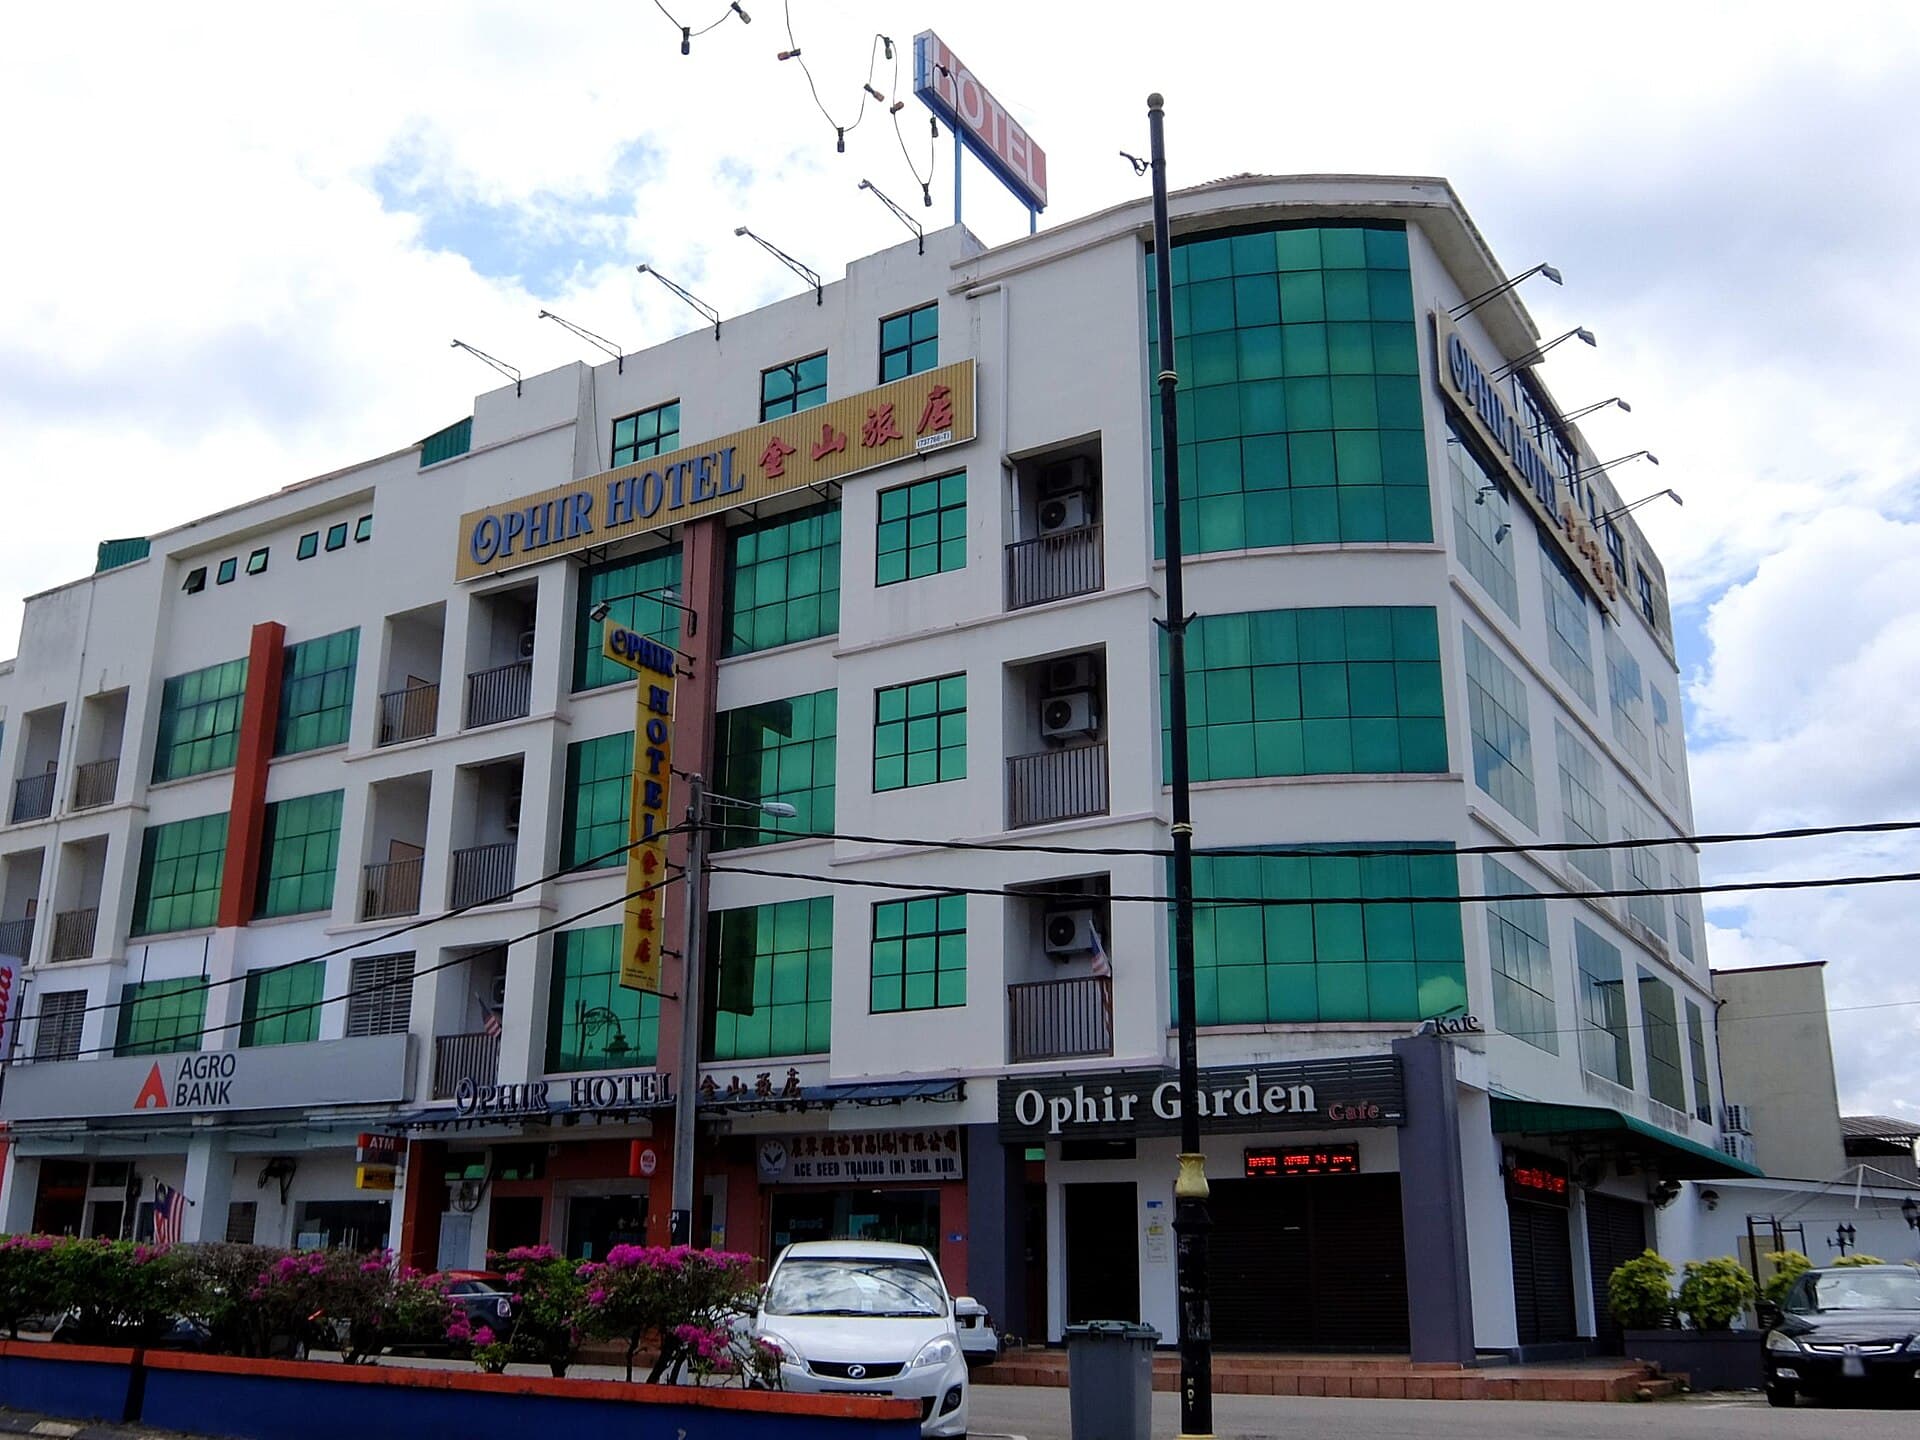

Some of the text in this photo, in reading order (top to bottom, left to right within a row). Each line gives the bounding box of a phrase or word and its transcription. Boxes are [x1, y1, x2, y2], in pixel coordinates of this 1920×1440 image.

[933, 38, 1046, 200] HOTEL
[759, 384, 954, 479] 金山旅店
[470, 446, 745, 565] OPHIR HOTEL
[610, 627, 675, 678] OPHIR
[642, 684, 670, 844] HOTEL
[1434, 1013, 1481, 1034] Kafe
[178, 1053, 236, 1080] AGRO
[175, 1080, 232, 1107] BANK
[456, 1071, 678, 1115] OPHIR HOTEL
[1015, 1085, 1138, 1134] Ophir
[1328, 1101, 1380, 1122] Cafe
[369, 1136, 395, 1150] ATM
[794, 1162, 812, 1177] ACE
[816, 1161, 840, 1176] SEED
[844, 1159, 885, 1177] TRADING
